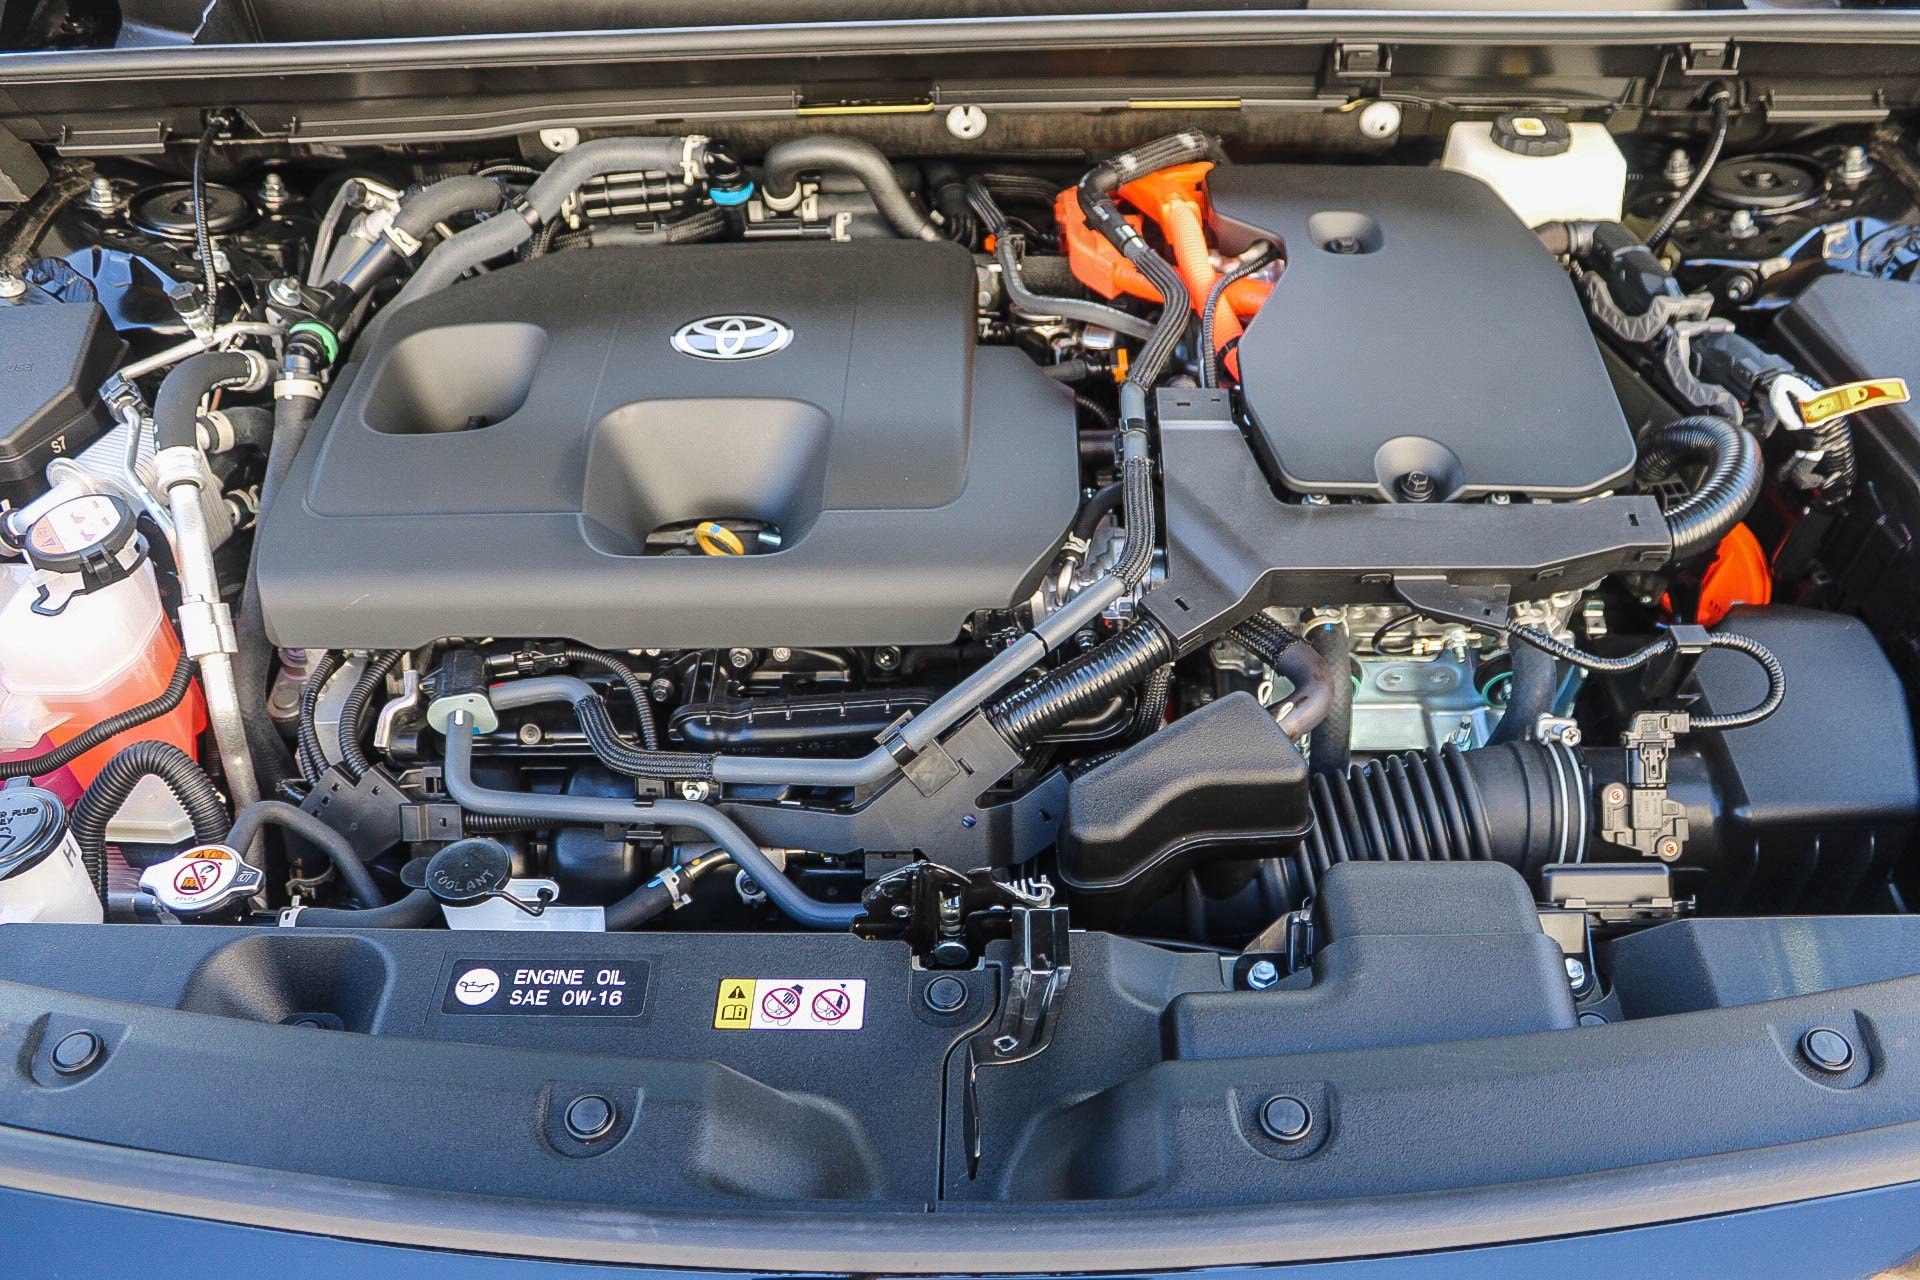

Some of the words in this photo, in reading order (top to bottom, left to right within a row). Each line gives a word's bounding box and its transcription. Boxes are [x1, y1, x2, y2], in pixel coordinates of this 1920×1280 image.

[433, 869, 495, 892] COOLANT
[513, 969, 585, 985] ENGINE
[596, 969, 626, 986] OIL
[509, 989, 551, 1006] SAE
[561, 990, 623, 1006] 0W-16
